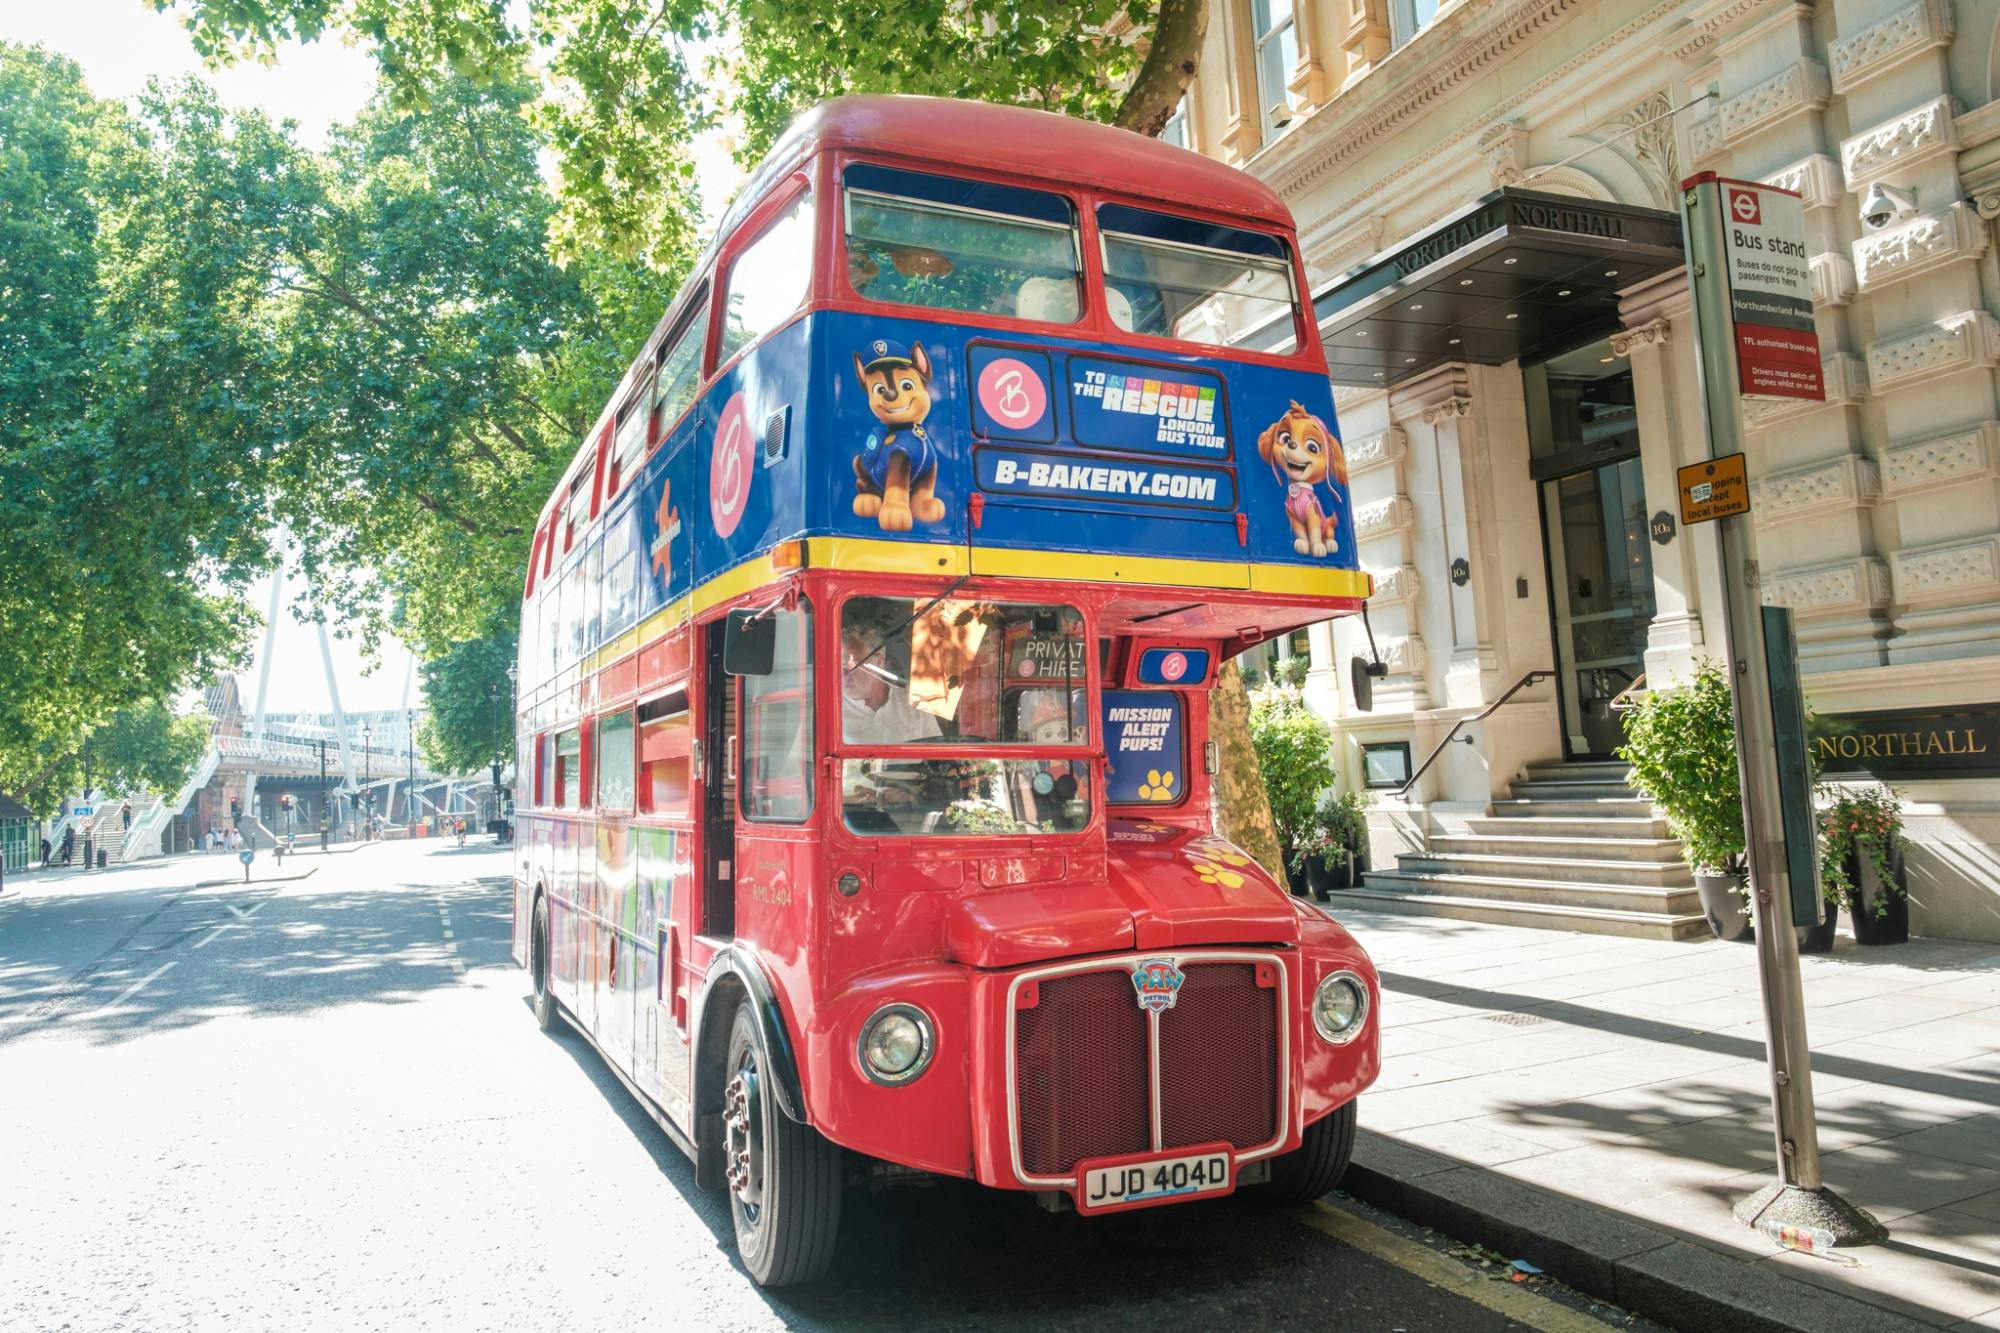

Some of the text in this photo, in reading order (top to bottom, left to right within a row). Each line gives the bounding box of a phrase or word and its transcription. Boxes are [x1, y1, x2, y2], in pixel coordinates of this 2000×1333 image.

[1514, 202, 1628, 239] NORTHALL
[1394, 211, 1498, 276] NORTHALL
[1734, 229, 1806, 258] Bus stand
[1737, 258, 1808, 279] Buses do not pick up
[1738, 271, 1797, 287] passengers here
[1735, 300, 1792, 315] Northumberland
[1756, 338, 1789, 349] authorised
[1789, 342, 1806, 352] buses
[1806, 346, 1818, 355] only
[1085, 370, 1106, 386] TO
[1752, 366, 1817, 382] Drivers must switch off
[1754, 378, 1818, 392] engines whilst on stand
[1073, 382, 1216, 422] THE RESCUE
[1159, 417, 1216, 435] LONDON
[1156, 429, 1226, 449] BUS TOUR
[995, 459, 1217, 501] B-BAKERY.COM
[1710, 475, 1742, 491] opping
[1687, 500, 1743, 519] local buses
[1025, 641, 1085, 658] PRIVAT
[1039, 660, 1080, 677] HIRE
[1109, 708, 1172, 722] MISSION
[1122, 723, 1170, 737] ALERT
[1119, 738, 1163, 752] PUPS!
[1817, 729, 1987, 759] NORTHALL
[1133, 968, 1184, 991] PAW
[1144, 994, 1172, 1003] PATROL
[1090, 1158, 1225, 1201] JJD 404D
